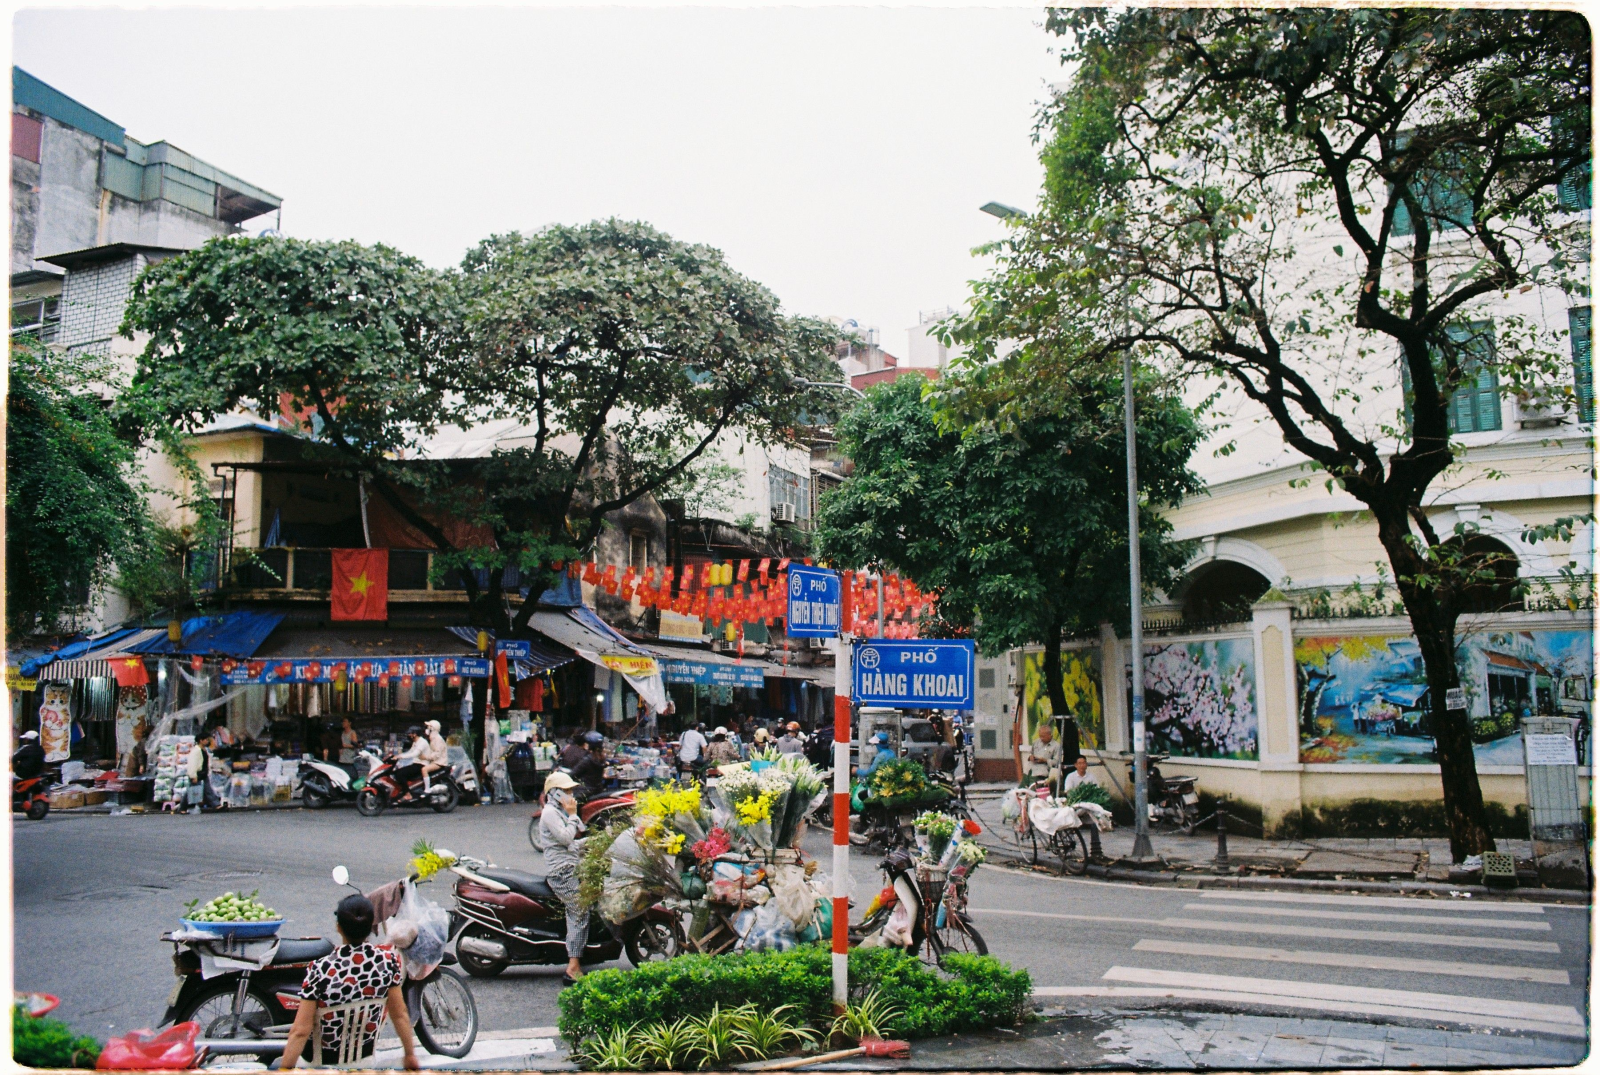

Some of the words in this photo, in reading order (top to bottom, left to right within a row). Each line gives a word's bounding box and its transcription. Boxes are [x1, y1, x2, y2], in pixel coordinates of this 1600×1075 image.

[810, 576, 827, 592] PHỐ
[791, 592, 811, 624] NGUYỄN
[900, 646, 939, 663] PHỐ
[861, 667, 907, 696] HÀNG
[912, 673, 964, 697] KHOAI
